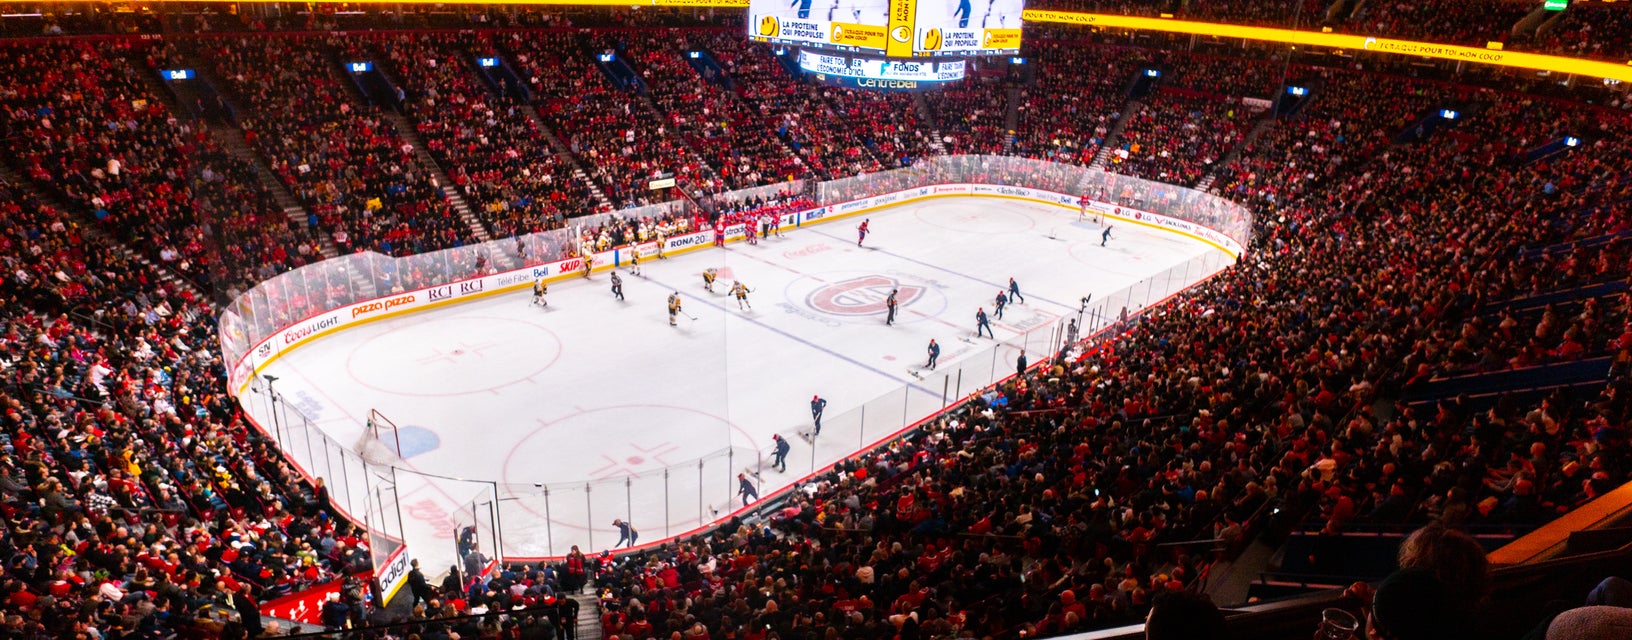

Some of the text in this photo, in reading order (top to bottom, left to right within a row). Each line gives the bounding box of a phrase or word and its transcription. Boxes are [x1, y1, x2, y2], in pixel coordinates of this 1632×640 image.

[1419, 46, 1442, 54] POUR
[820, 55, 833, 65] FAIRE
[170, 69, 186, 80] Bell
[893, 63, 919, 73] FONDS
[1060, 196, 1072, 204] Bell
[1121, 209, 1131, 217] LG
[1142, 214, 1152, 222] LG
[670, 237, 695, 248] RONA
[695, 235, 706, 245] 20
[558, 259, 580, 274] SKIP
[513, 272, 529, 285] Fibe
[533, 266, 549, 278] Bell
[428, 285, 452, 300] RCI
[460, 279, 483, 293] RCI
[351, 295, 415, 318] pizza pizza
[283, 316, 339, 344] Coors LIGHT
[258, 341, 271, 354] SN
